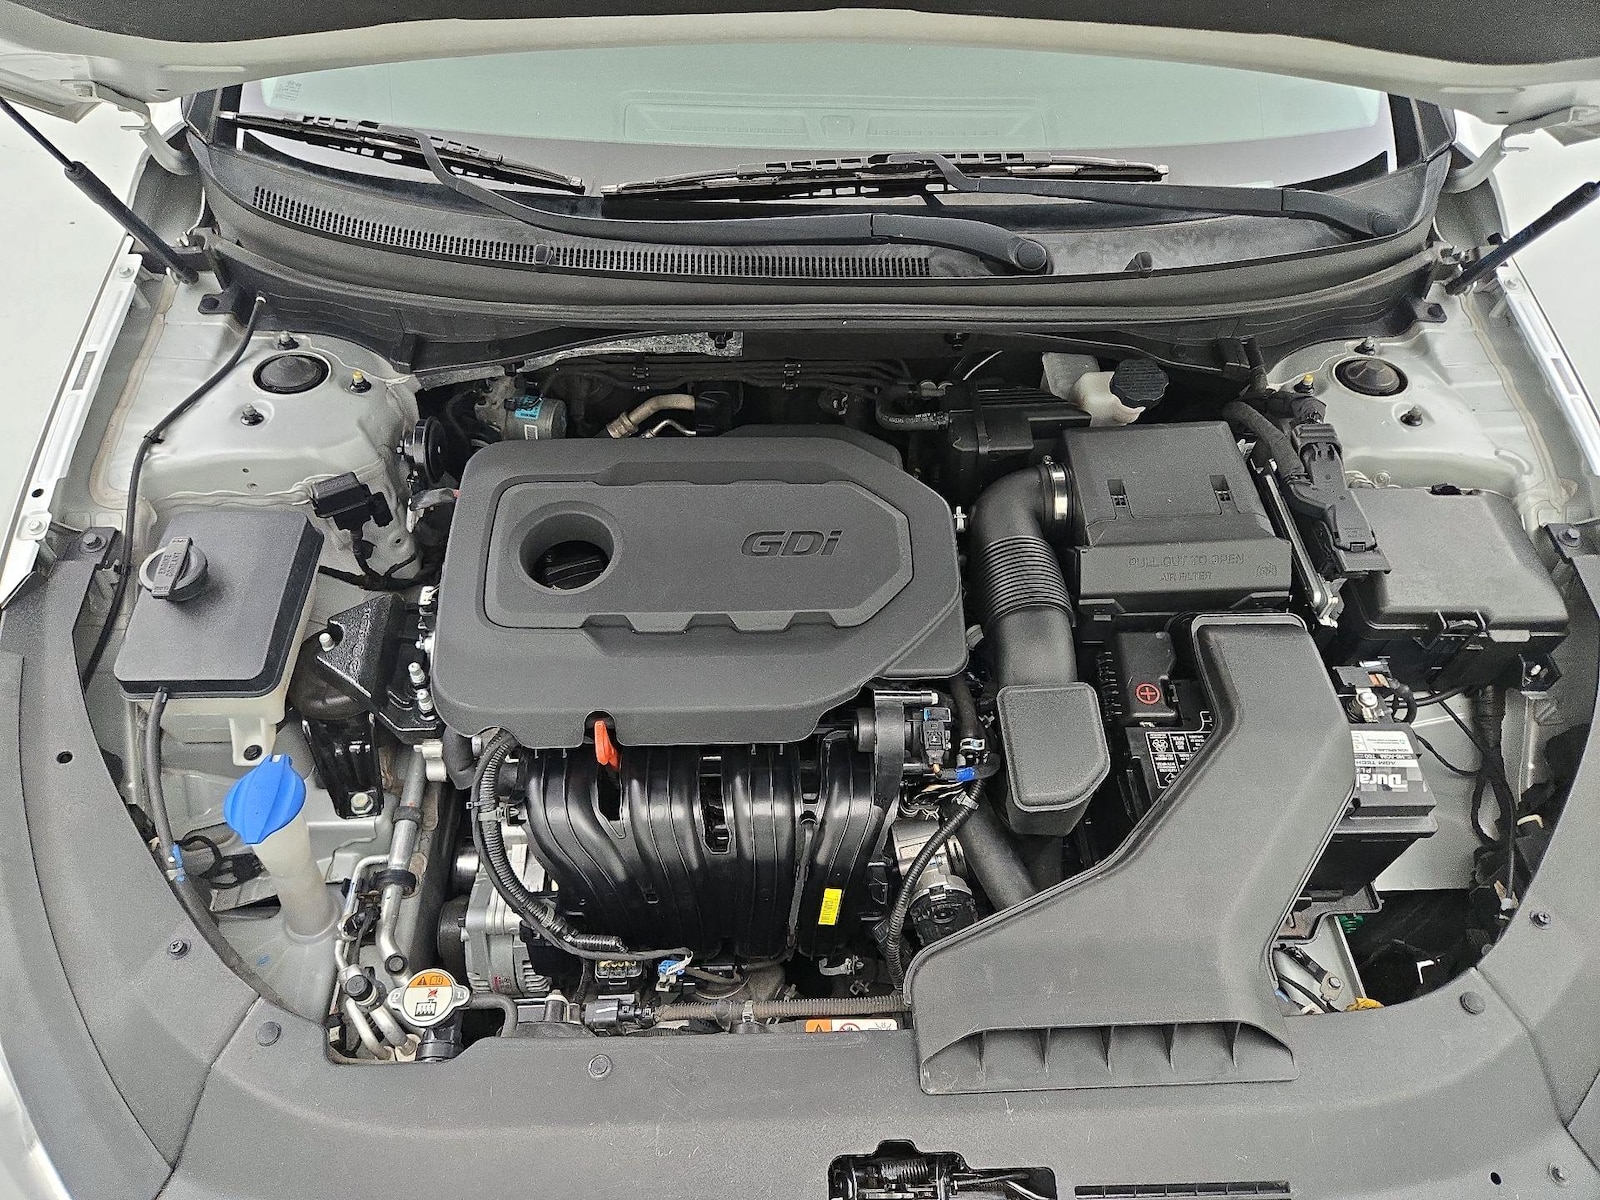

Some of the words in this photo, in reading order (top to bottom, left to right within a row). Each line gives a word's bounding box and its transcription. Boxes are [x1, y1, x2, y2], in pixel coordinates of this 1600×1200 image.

[740, 529, 843, 557] GDi
[1129, 556, 1160, 568] PULL
[1211, 552, 1244, 565] OPEN
